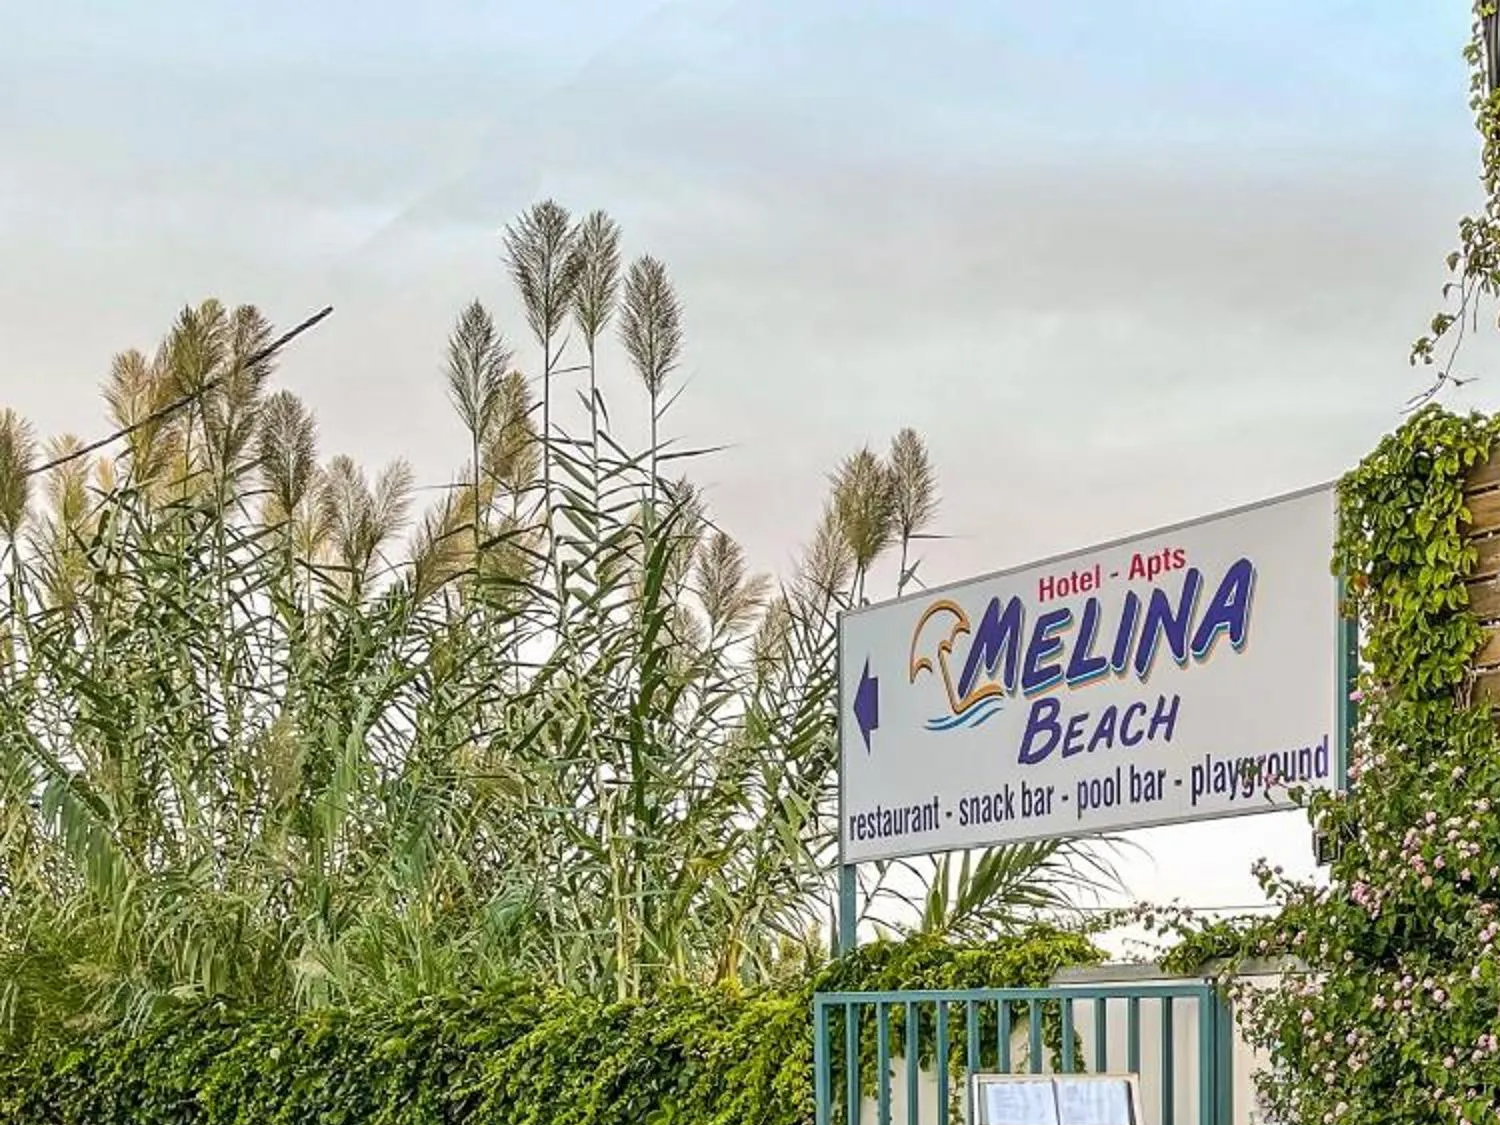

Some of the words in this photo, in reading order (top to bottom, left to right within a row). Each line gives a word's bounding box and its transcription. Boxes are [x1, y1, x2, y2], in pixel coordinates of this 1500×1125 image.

[1039, 564, 1100, 602] Hotel
[1128, 548, 1186, 582] Apts
[957, 557, 1257, 699] MELINA
[1018, 694, 1180, 765] BEACH
[850, 796, 940, 841] restaurant
[959, 783, 1015, 826] snack
[1021, 780, 1054, 818] bar
[1077, 766, 1121, 820] pool
[1129, 764, 1166, 803] bar
[1191, 735, 1329, 806] playground
